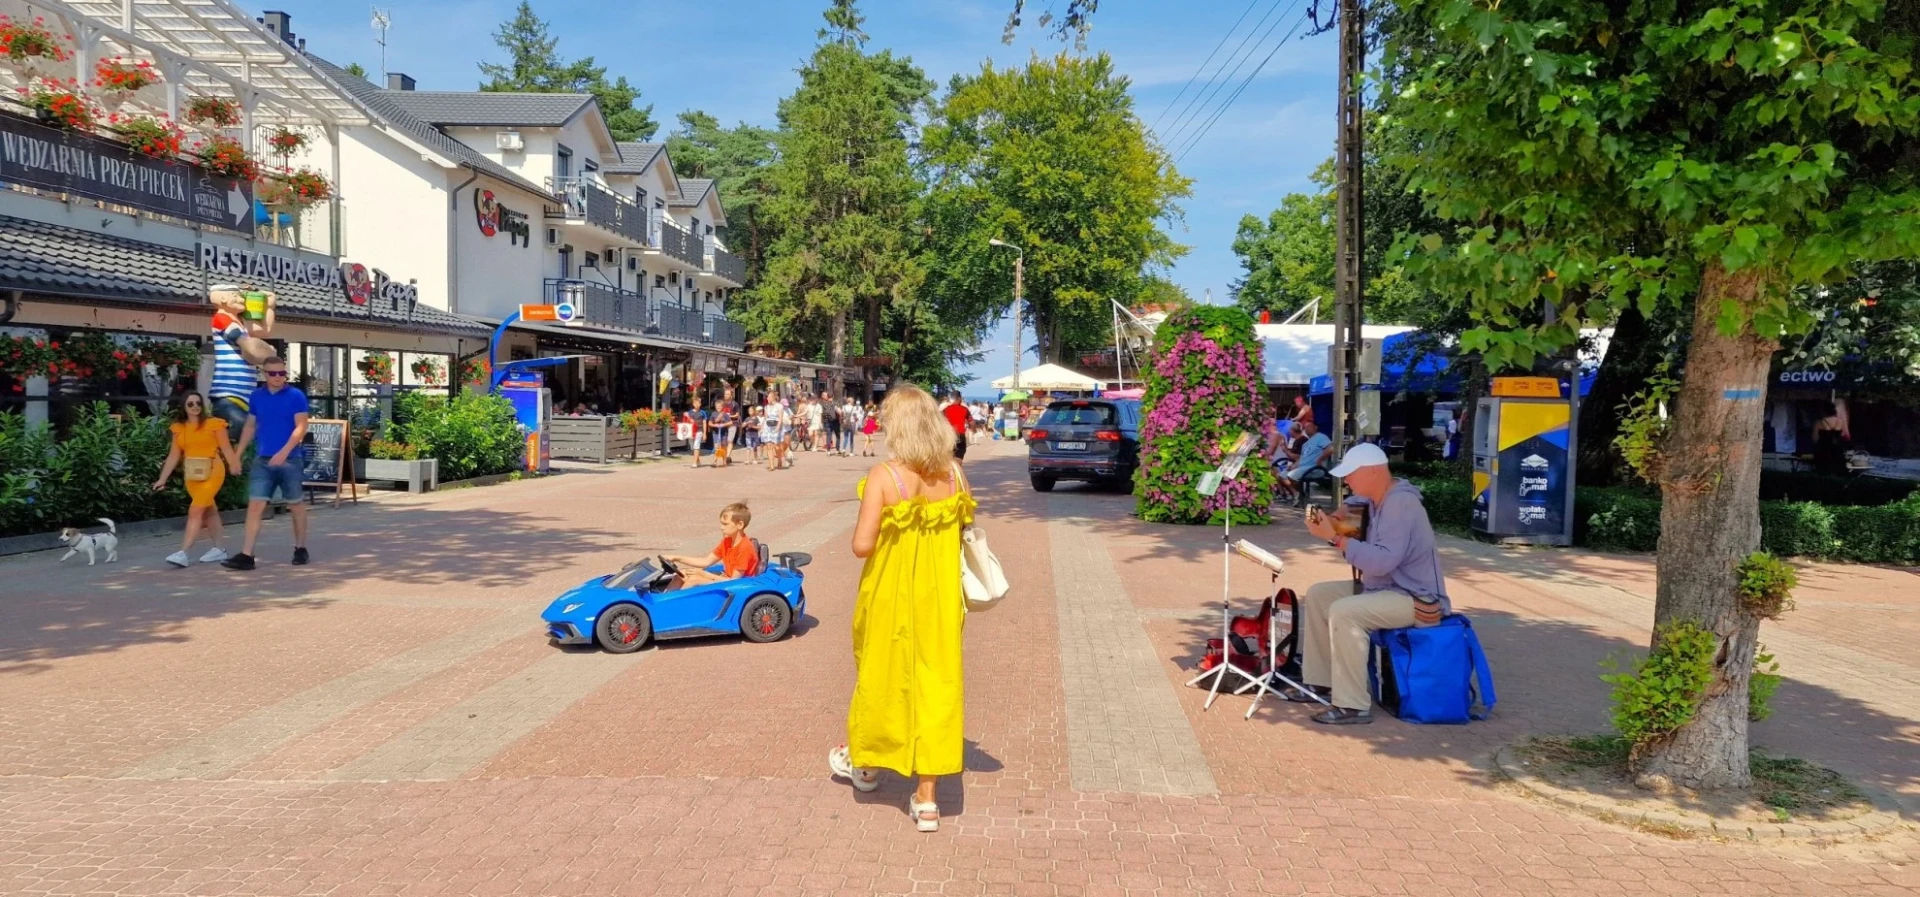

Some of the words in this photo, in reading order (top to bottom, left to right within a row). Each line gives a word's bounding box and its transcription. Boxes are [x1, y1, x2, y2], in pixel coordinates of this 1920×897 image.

[2, 130, 96, 181] WĘDZARNIA
[101, 155, 186, 202] PRZYPIECEK
[200, 243, 342, 289] RESTAURACJA
[1522, 476, 1548, 484] banko
[1530, 512, 1546, 520] mat
